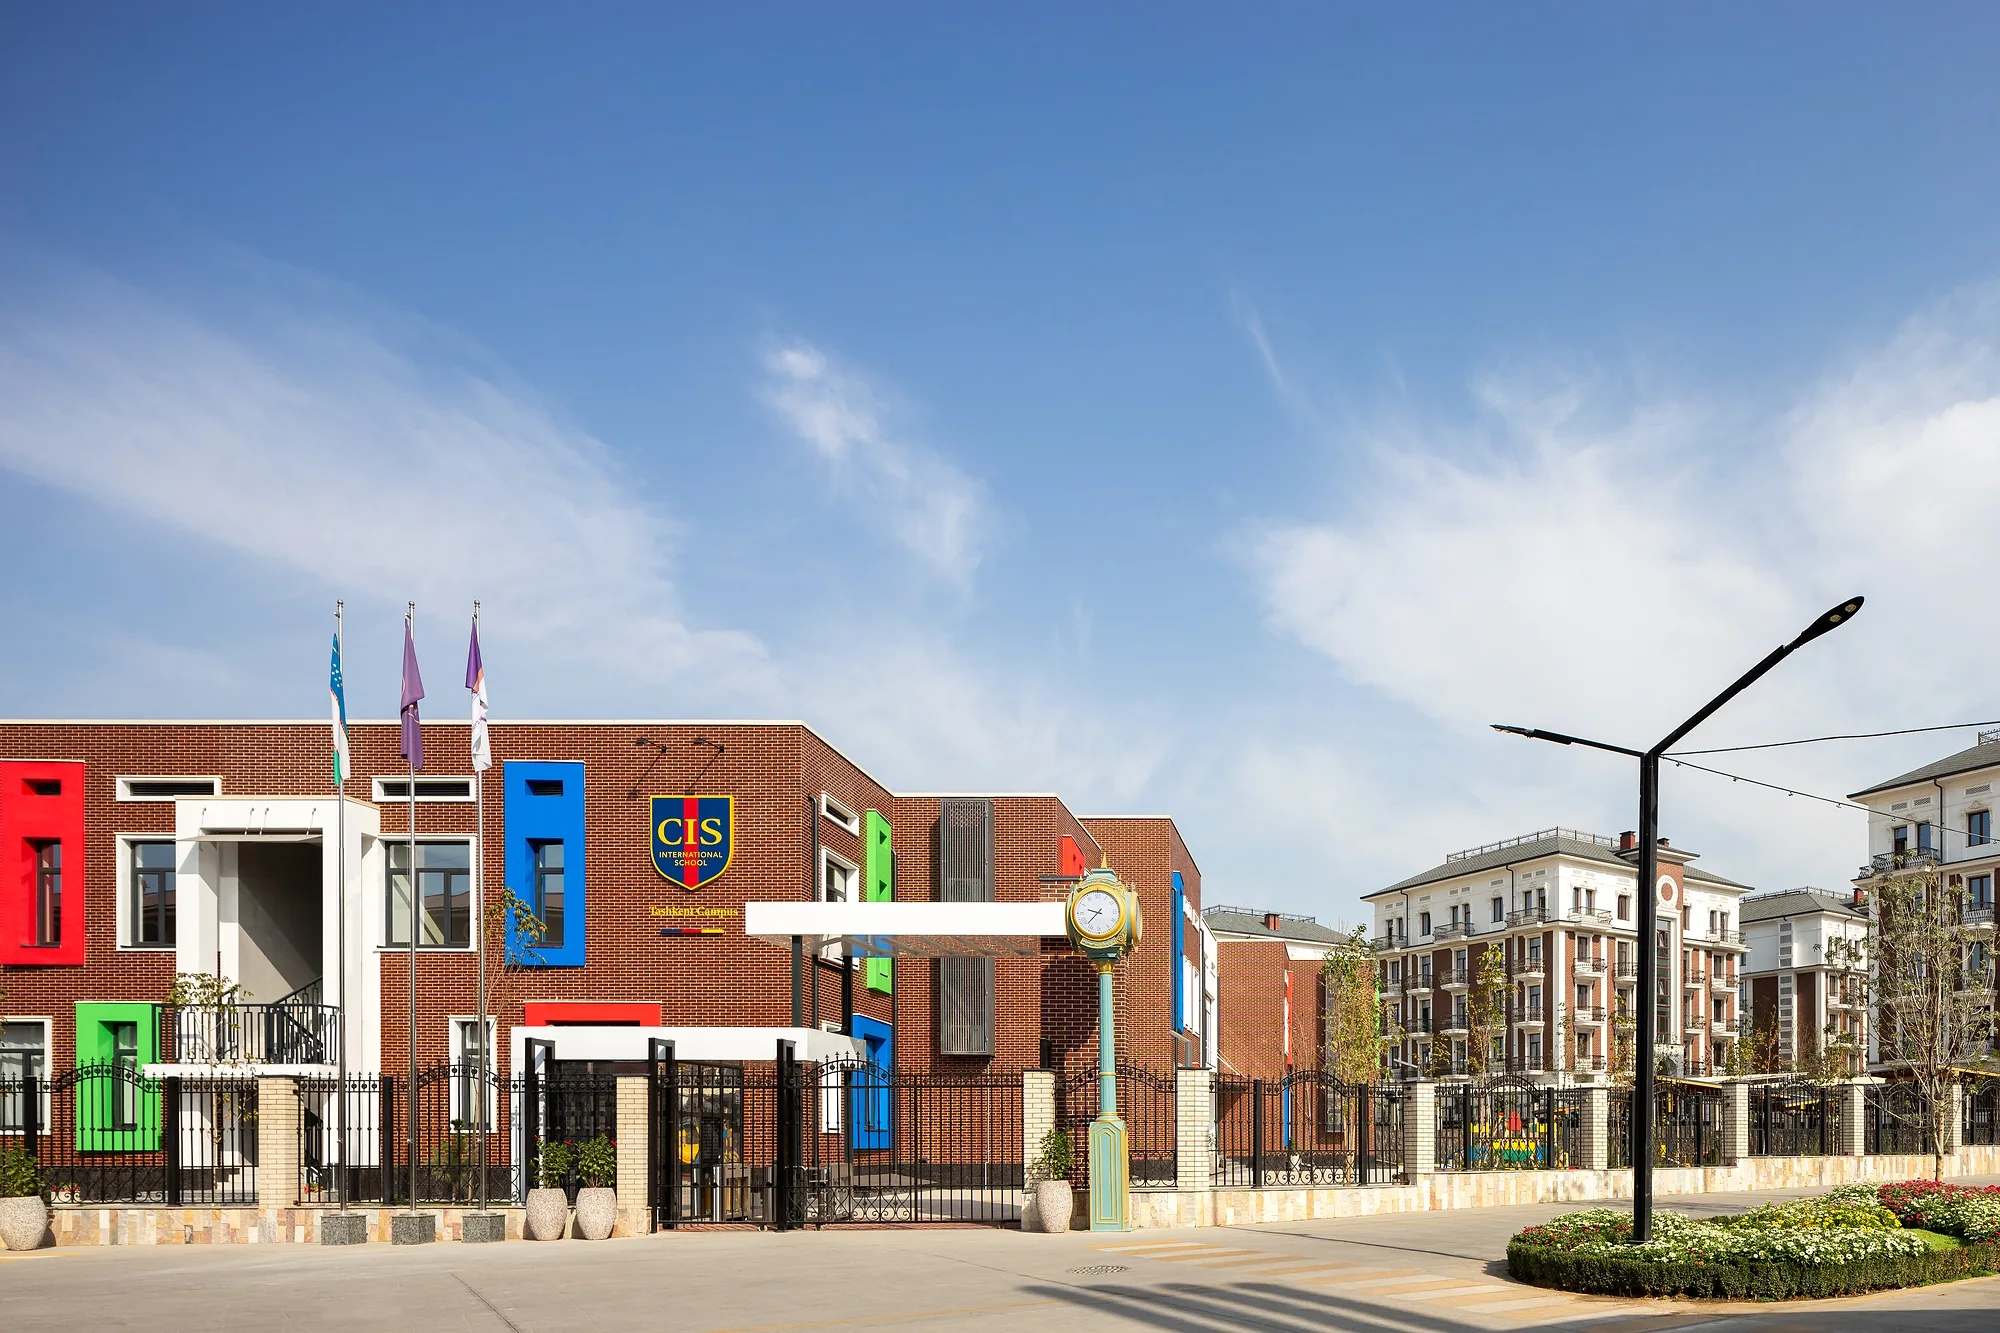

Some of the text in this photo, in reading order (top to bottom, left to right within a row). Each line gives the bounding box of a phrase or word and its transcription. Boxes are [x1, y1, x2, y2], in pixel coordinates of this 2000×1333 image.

[657, 818, 723, 846] CIS
[659, 851, 723, 859] INTERNATIONAL
[674, 859, 708, 867] SCHOOL
[650, 905, 739, 919] Tashkent Campus
